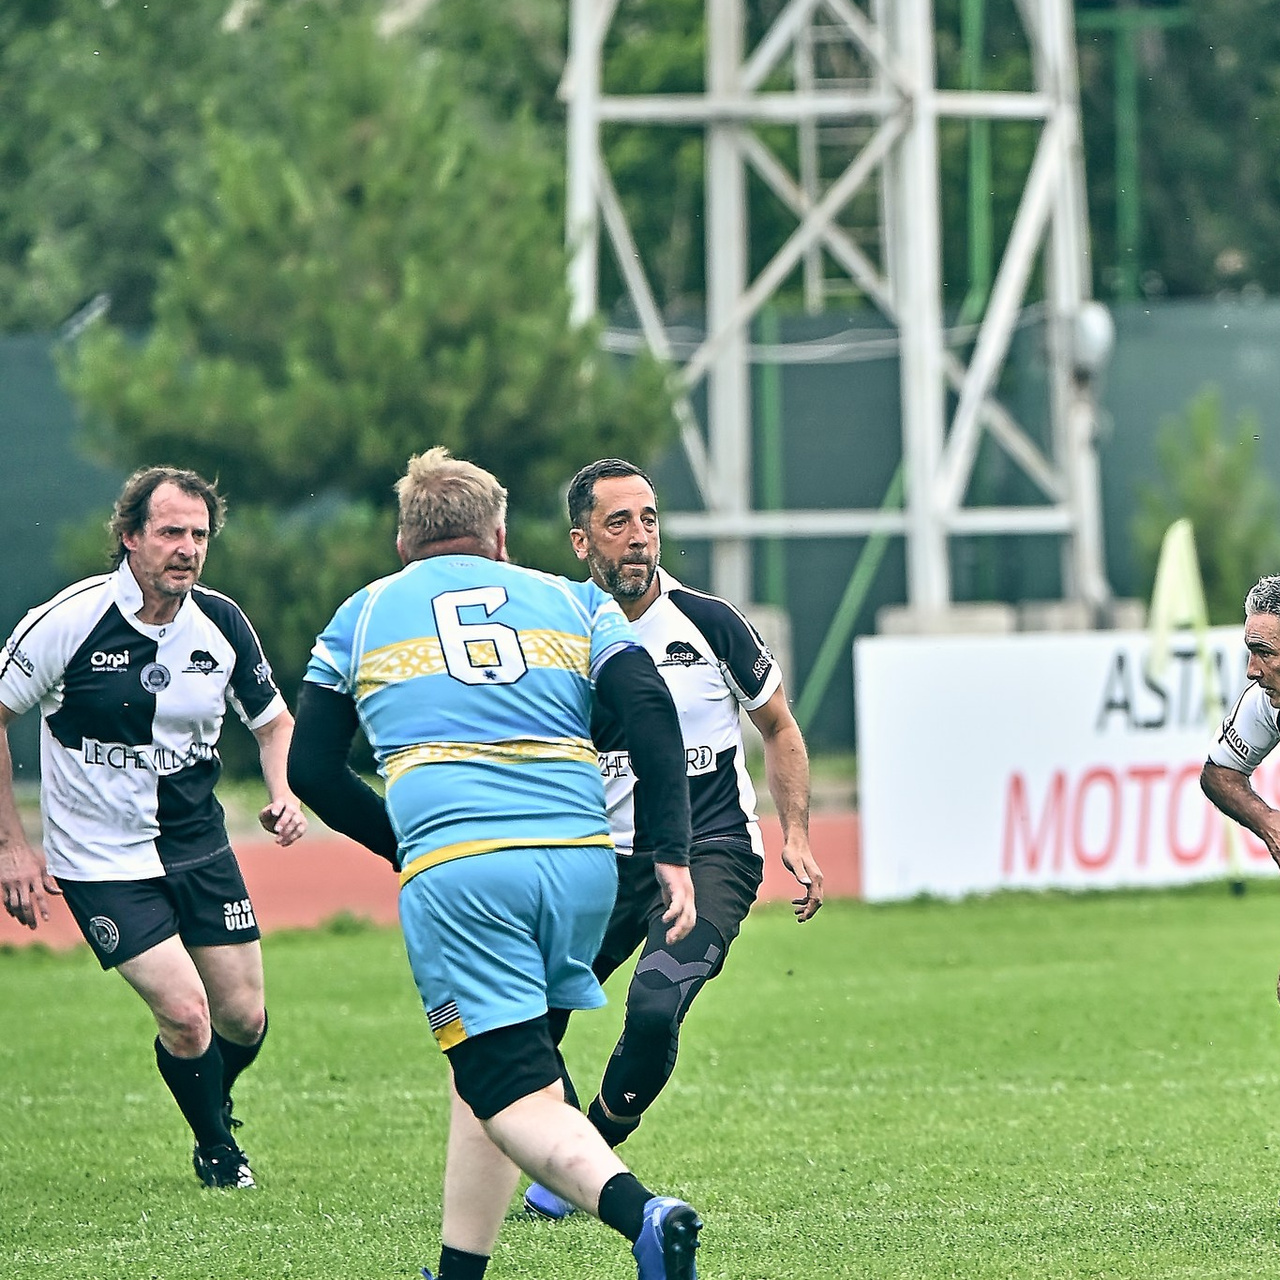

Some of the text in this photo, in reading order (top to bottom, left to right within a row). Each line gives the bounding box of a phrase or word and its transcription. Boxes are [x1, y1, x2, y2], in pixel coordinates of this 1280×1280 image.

[431, 586, 528, 685] 6
[90, 649, 130, 668] Orpi
[665, 652, 694, 662] ACSB
[1096, 648, 1250, 731] ASTA
[84, 740, 209, 771] LE CHEVILL
[224, 911, 256, 931] ULLA
